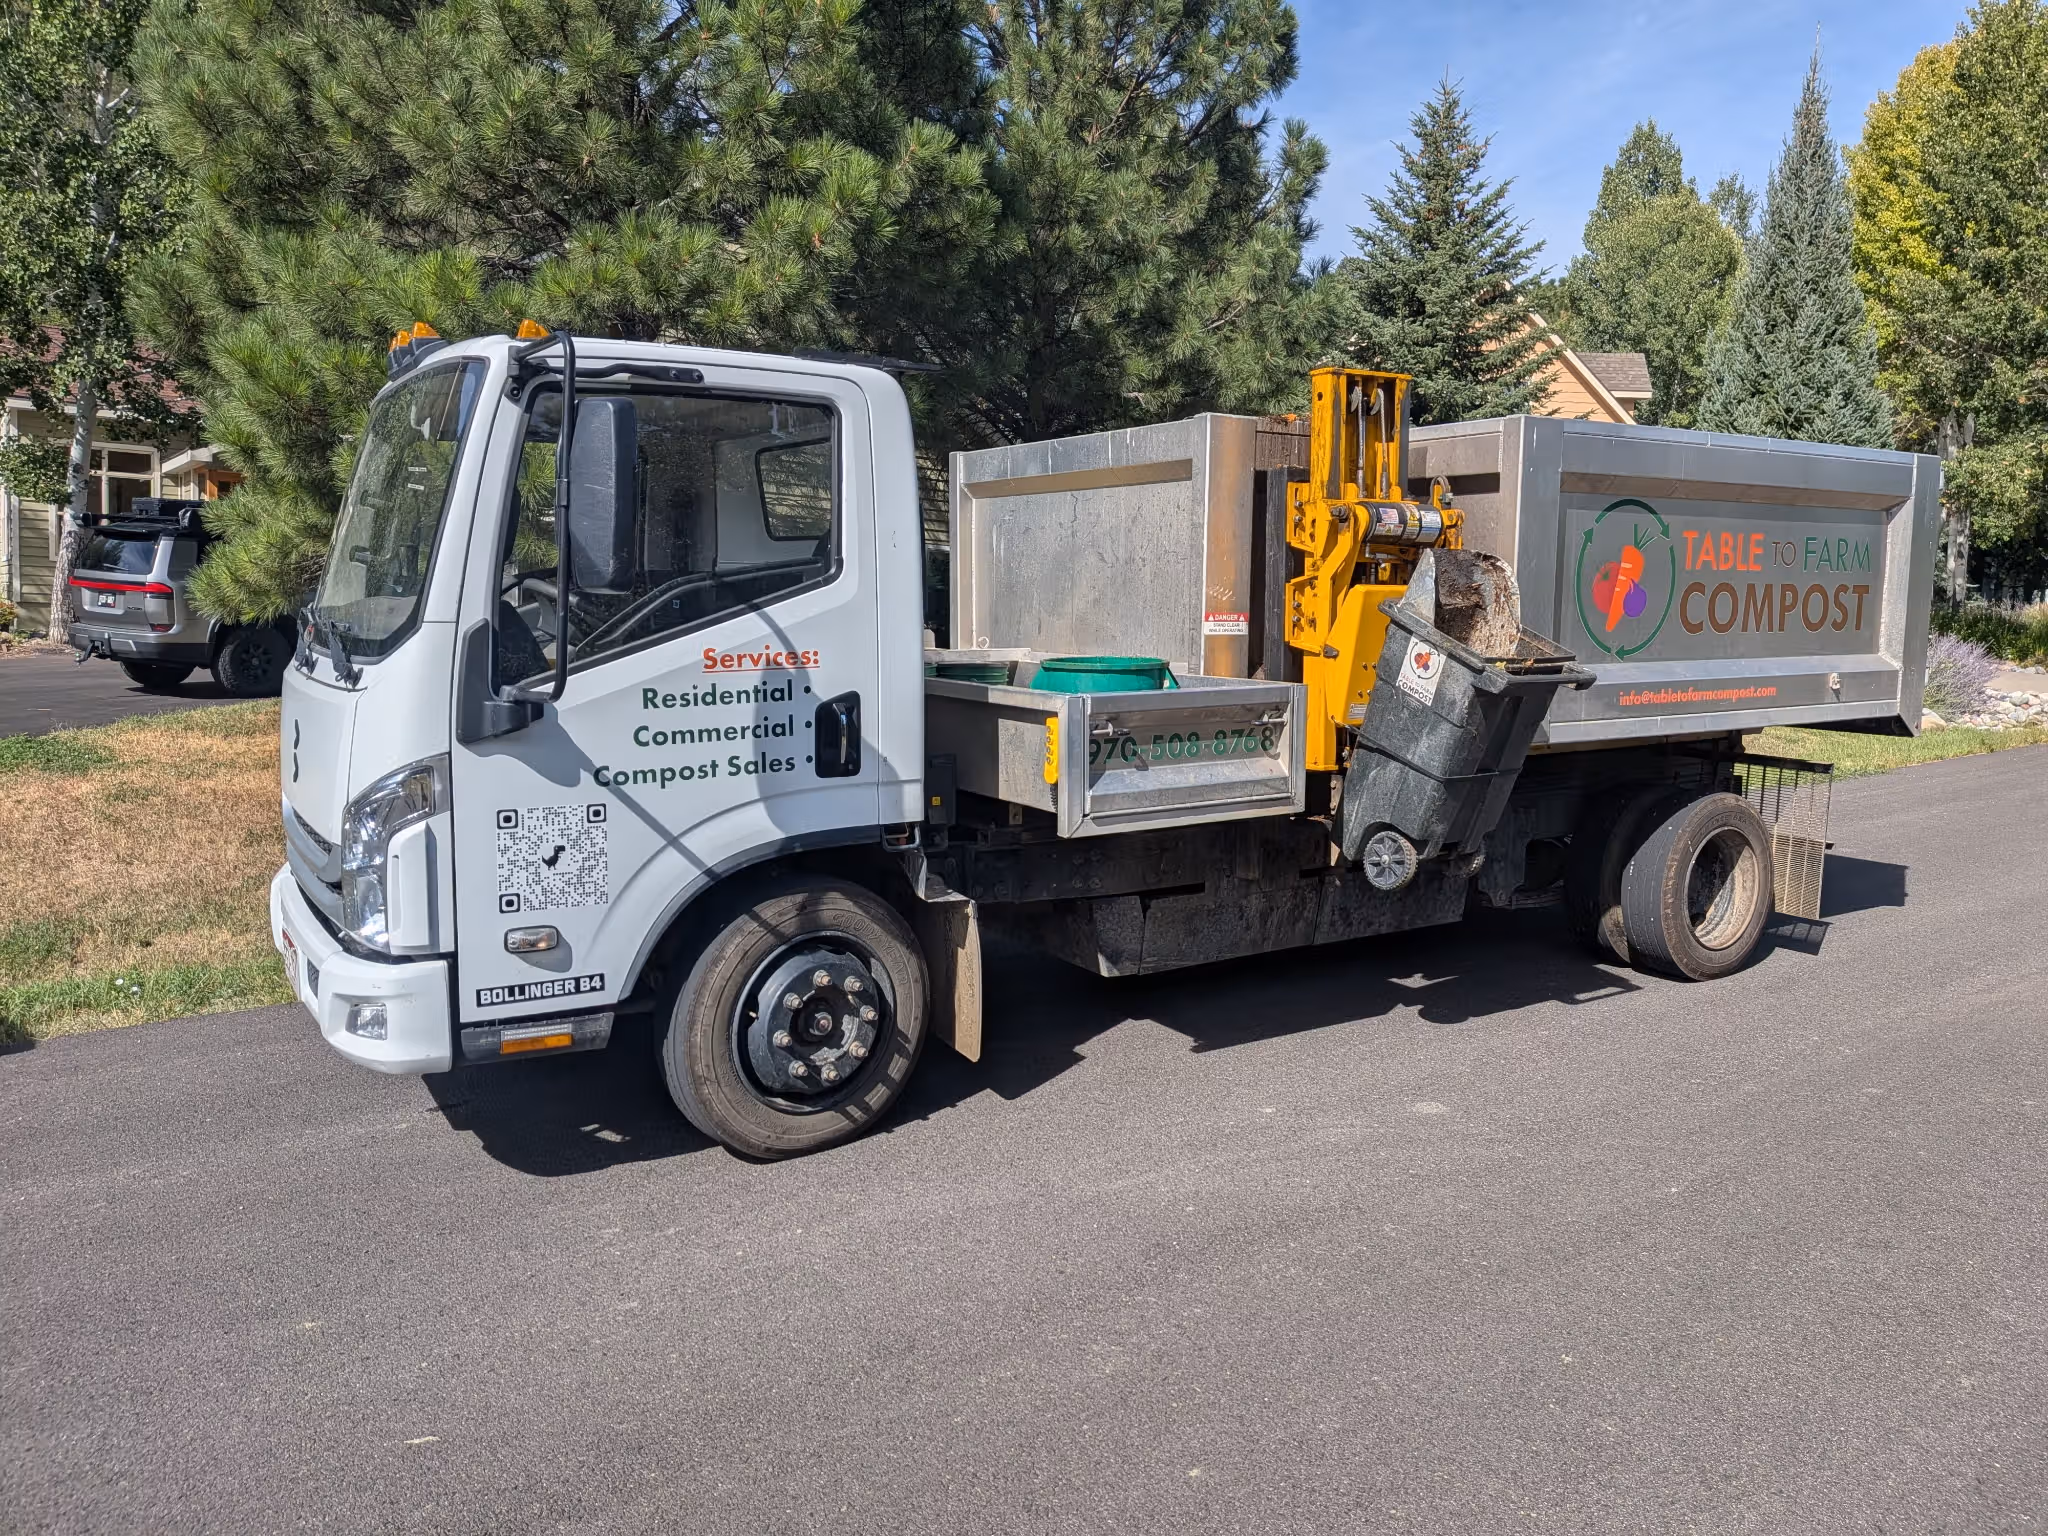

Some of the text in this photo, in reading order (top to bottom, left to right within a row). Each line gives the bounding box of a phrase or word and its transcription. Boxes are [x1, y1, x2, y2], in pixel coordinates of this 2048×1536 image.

[1682, 531, 1872, 572] TABLE TO FARM
[1679, 581, 1870, 635] COMPOST
[702, 645, 820, 671] Services:
[642, 679, 793, 710] Residential
[1619, 686, 1777, 706] info@tabletofarmcompost.com
[633, 714, 794, 747] Commercial
[1088, 726, 1275, 765] 970-508-8768
[593, 752, 796, 789] Compost Sales
[832, 912, 909, 985] GOODYEAR
[480, 975, 602, 1005] BOLLINGER B4
